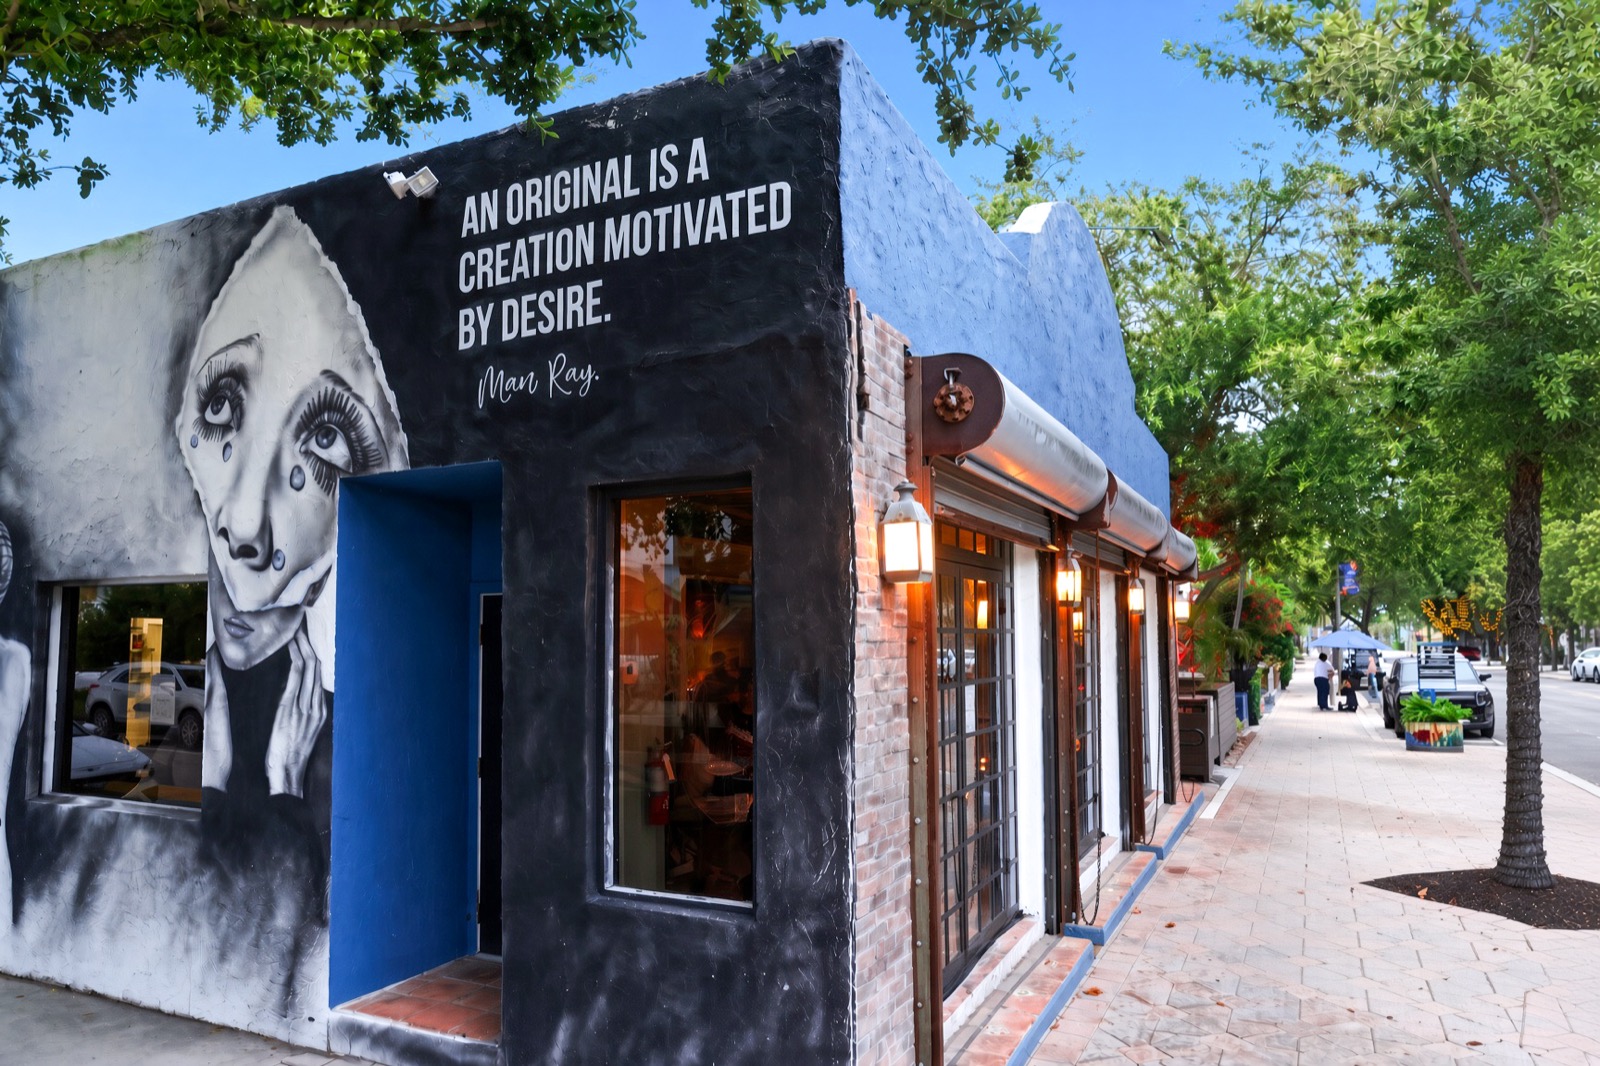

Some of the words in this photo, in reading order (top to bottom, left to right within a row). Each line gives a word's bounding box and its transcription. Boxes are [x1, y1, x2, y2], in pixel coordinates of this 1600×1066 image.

[462, 189, 498, 237] AN
[507, 155, 639, 225] ORIGINAL
[650, 144, 678, 192] IS
[687, 137, 709, 183] A
[459, 222, 594, 293] CREATION
[604, 182, 791, 262] MOTIVATED
[459, 303, 494, 350] BY
[502, 280, 611, 341] DESIRE.
[479, 366, 538, 408] Man
[549, 353, 599, 398] Ray.
